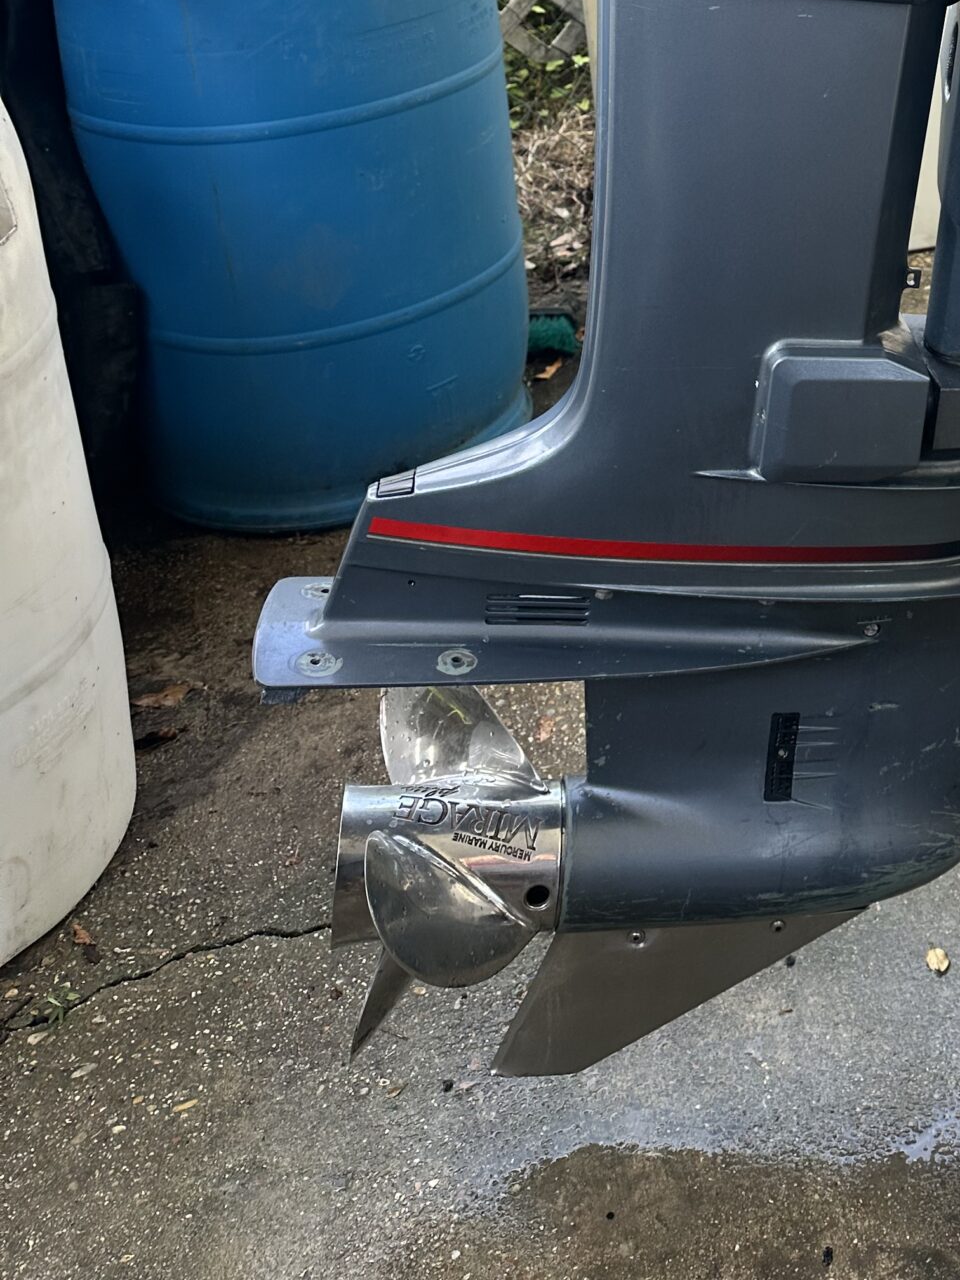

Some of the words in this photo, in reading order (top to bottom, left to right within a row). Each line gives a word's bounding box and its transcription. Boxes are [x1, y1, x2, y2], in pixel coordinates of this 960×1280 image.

[392, 795, 544, 852] MIRAGE
[451, 831, 488, 850] MARINE
[487, 842, 533, 862] MERCURY
